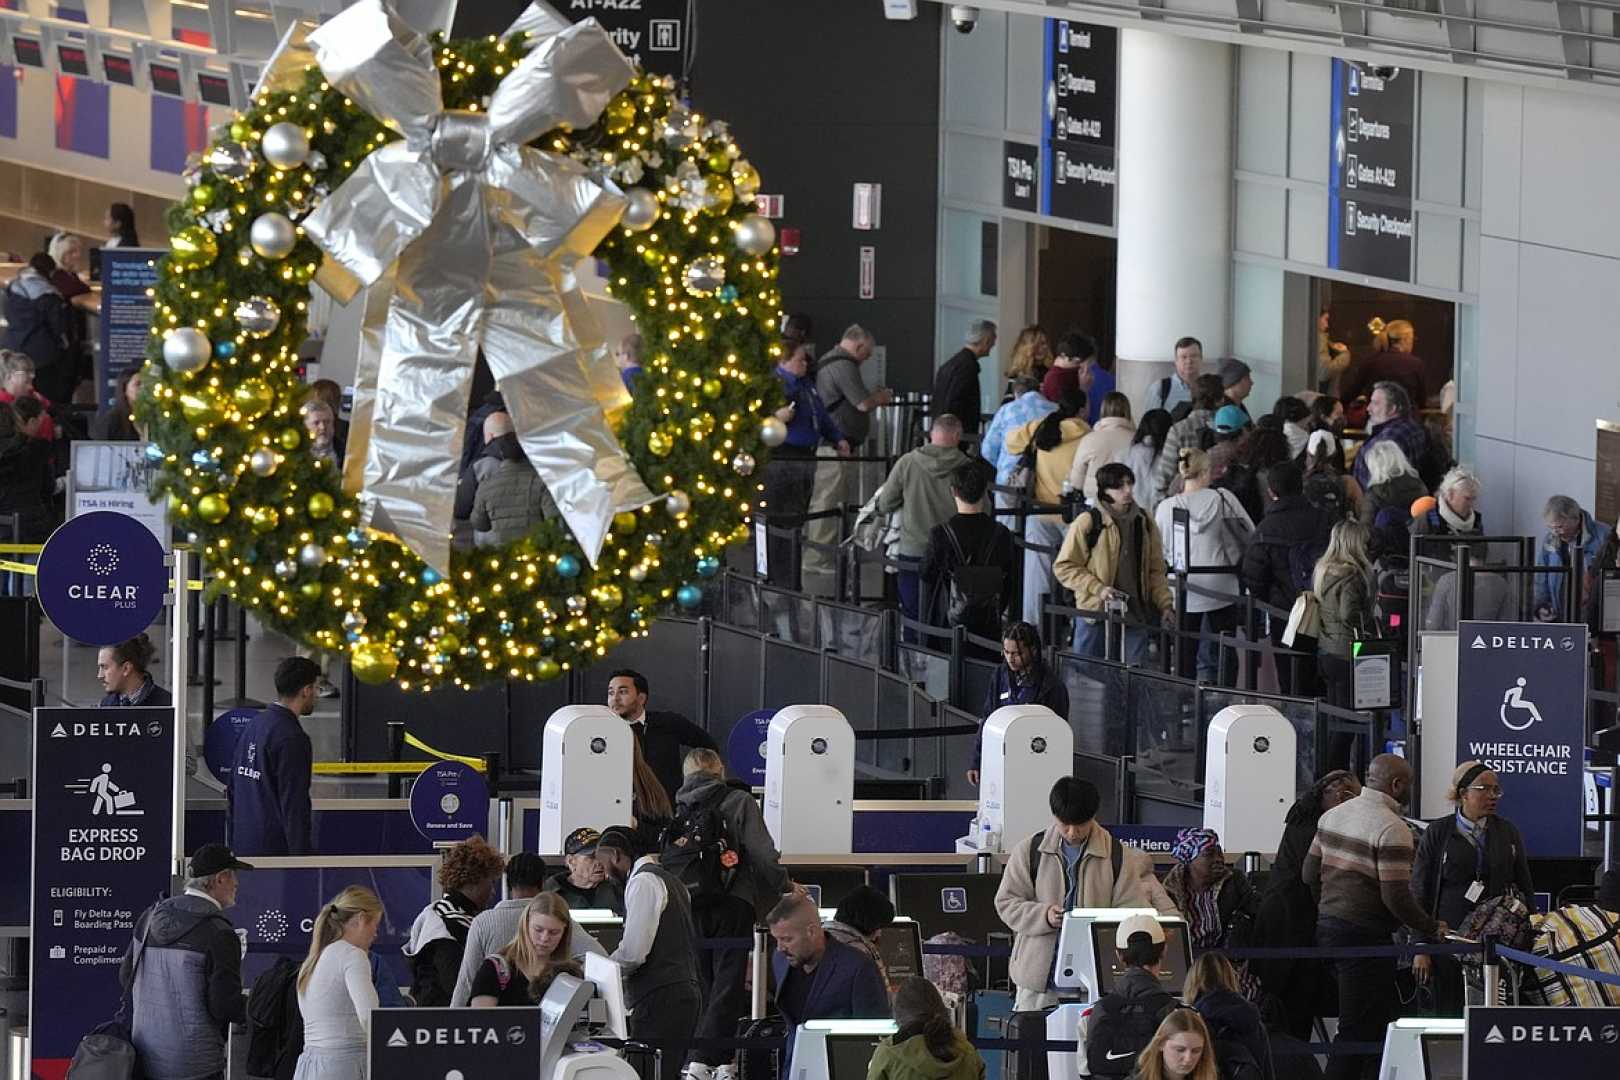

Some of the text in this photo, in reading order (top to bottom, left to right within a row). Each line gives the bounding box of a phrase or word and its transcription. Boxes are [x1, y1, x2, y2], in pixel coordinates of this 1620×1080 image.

[609, 27, 641, 49] rity
[1360, 118, 1389, 140] Departures
[1066, 160, 1086, 183] Security
[1358, 164, 1374, 183] Gates
[1357, 210, 1379, 235] Security
[68, 585, 137, 599] CLEAR
[114, 601, 136, 609] PLUS
[1492, 636, 1555, 650] DELTA
[74, 723, 141, 736] DELTA
[1470, 742, 1571, 758] WHEELCHAIR
[1475, 759, 1567, 775] SSISTANCE
[68, 828, 139, 843] EXPRESS
[1120, 838, 1171, 850] ait Here
[60, 847, 146, 861] BAG DROP
[50, 887, 112, 898] ELIGIBILITY:
[74, 909, 132, 920] Fly Delta App
[74, 920, 133, 930] Boarding Pass
[73, 945, 106, 955] Prepaid
[416, 1028, 499, 1044] DELTA
[1511, 1025, 1593, 1041] DELTA
